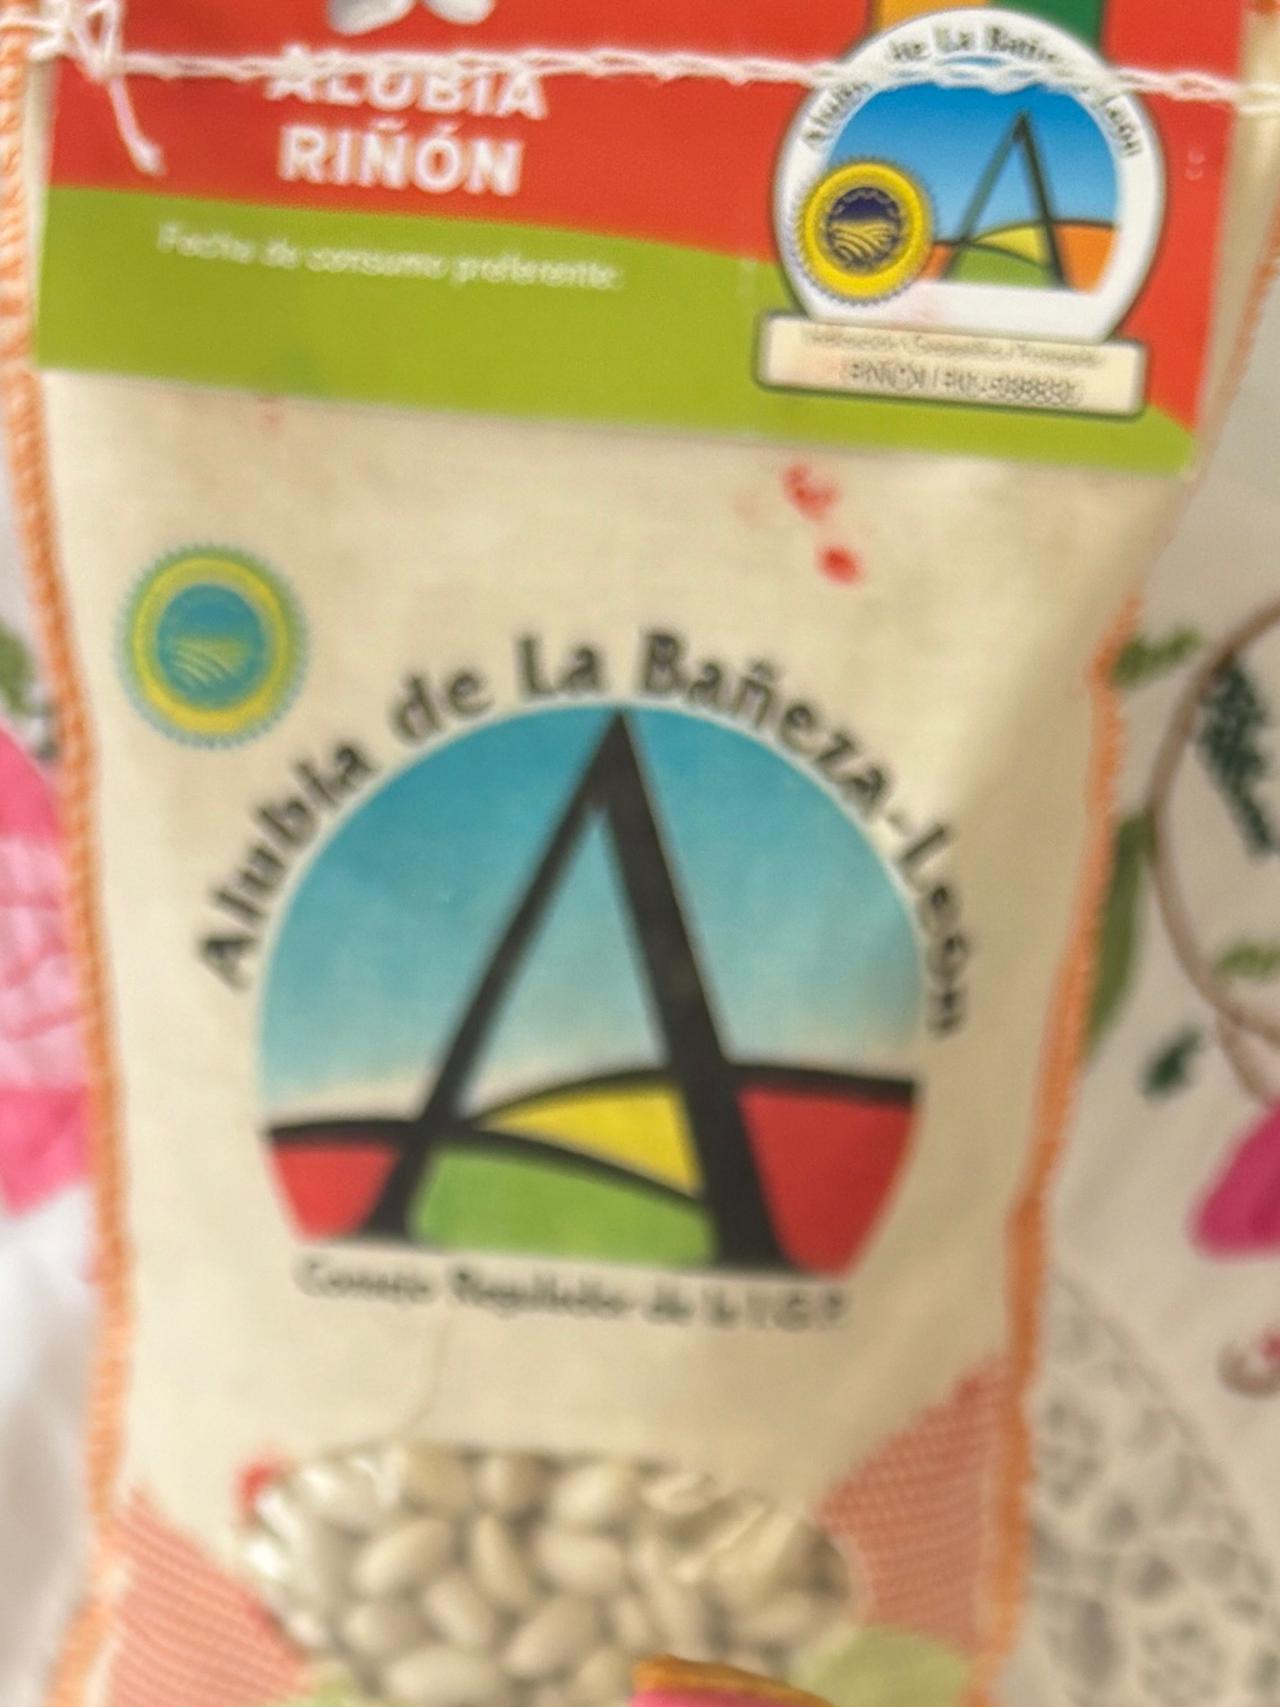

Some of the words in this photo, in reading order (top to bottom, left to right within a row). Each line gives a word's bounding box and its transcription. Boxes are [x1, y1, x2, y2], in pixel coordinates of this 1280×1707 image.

[266, 44, 548, 120] ALUBIA
[277, 117, 524, 197] RIÑÓN
[158, 222, 256, 264] Fecha
[261, 238, 299, 269] de
[305, 248, 448, 279] consumo
[197, 742, 382, 994] Alubia
[387, 666, 495, 750] de
[514, 632, 602, 698] La
[626, 628, 970, 1036] Bañeza-León
